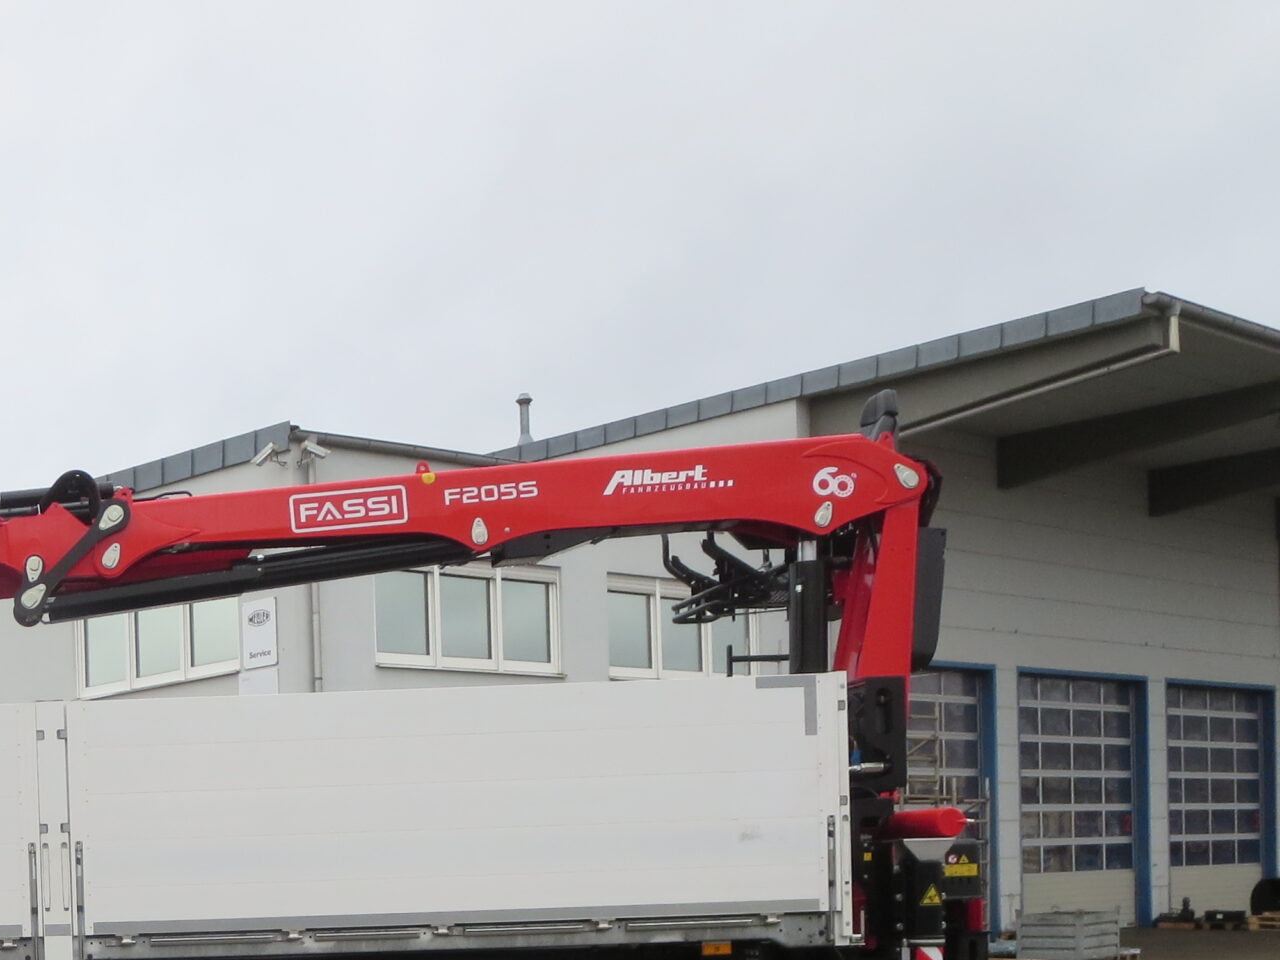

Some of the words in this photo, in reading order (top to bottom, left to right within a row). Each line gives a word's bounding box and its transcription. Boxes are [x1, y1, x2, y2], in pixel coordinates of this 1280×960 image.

[603, 464, 708, 495] Albert
[443, 481, 539, 505] F205S
[299, 495, 399, 523] FASSI
[248, 649, 272, 660] Service
